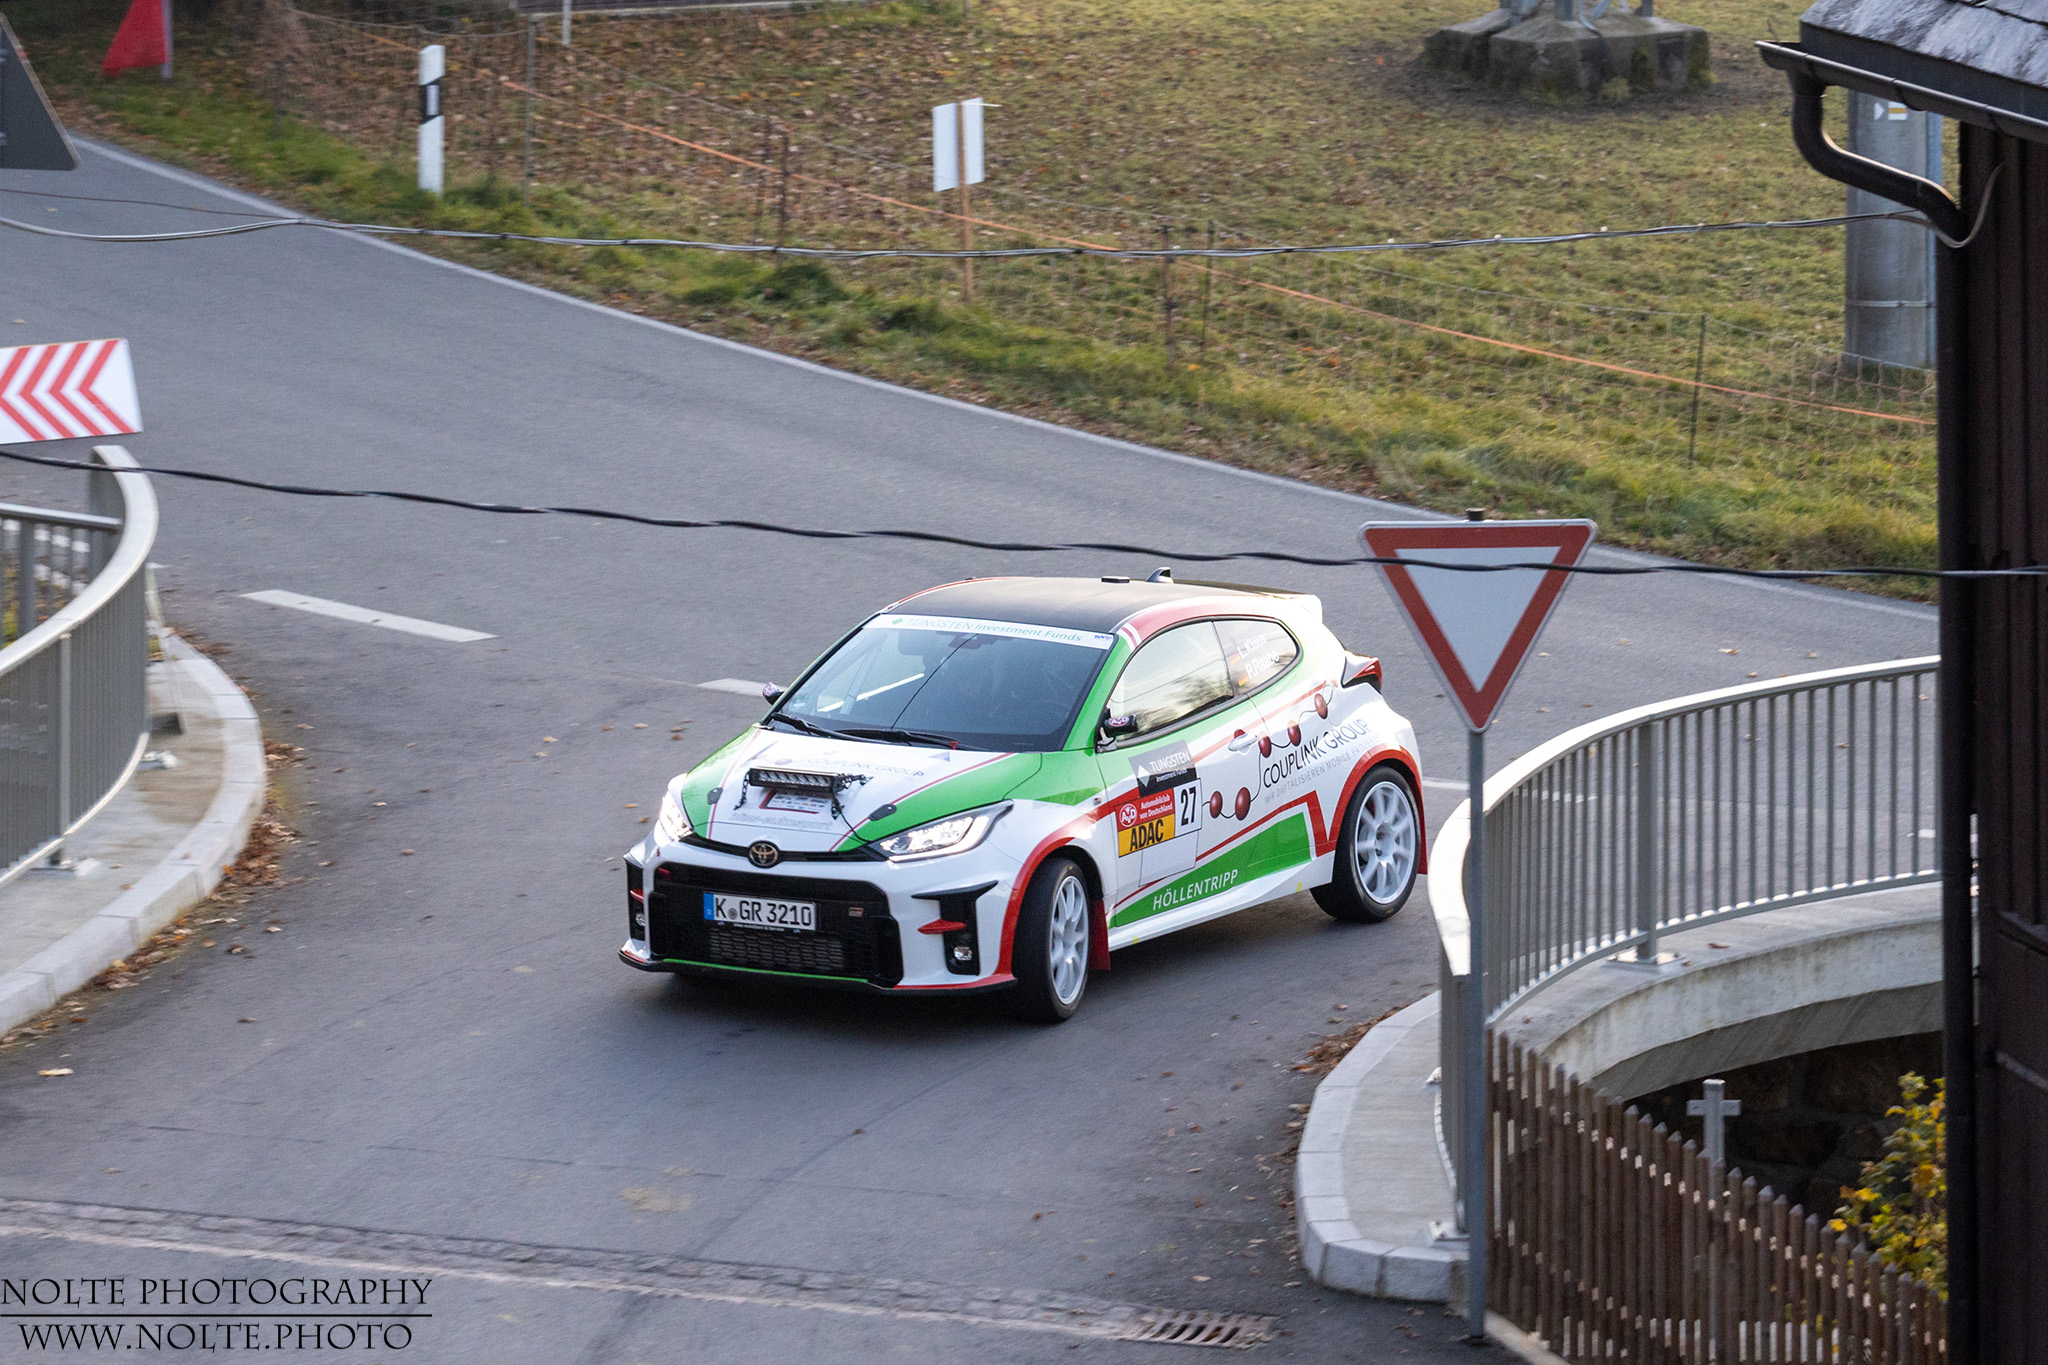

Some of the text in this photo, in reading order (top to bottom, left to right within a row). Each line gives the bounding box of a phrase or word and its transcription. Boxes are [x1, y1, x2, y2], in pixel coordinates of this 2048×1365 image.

[906, 618, 975, 630] TUNGSTEN
[975, 623, 1043, 636] Investment
[1044, 630, 1082, 642] Funds
[1149, 751, 1191, 772] TUNGSTEN
[1263, 719, 1371, 788] COUPLINK GROUP
[1326, 752, 1351, 771] MOBILE
[808, 757, 925, 777] COUPLINK GROUP
[1155, 771, 1177, 783] Investment
[1140, 794, 1171, 809] Automobilclub
[1148, 802, 1173, 817] Deutschland
[1180, 786, 1197, 826] 27
[1130, 818, 1164, 852] ADAC
[1152, 869, 1238, 911] HÖLLENTRIPP
[715, 898, 812, 926] K GR 3210
